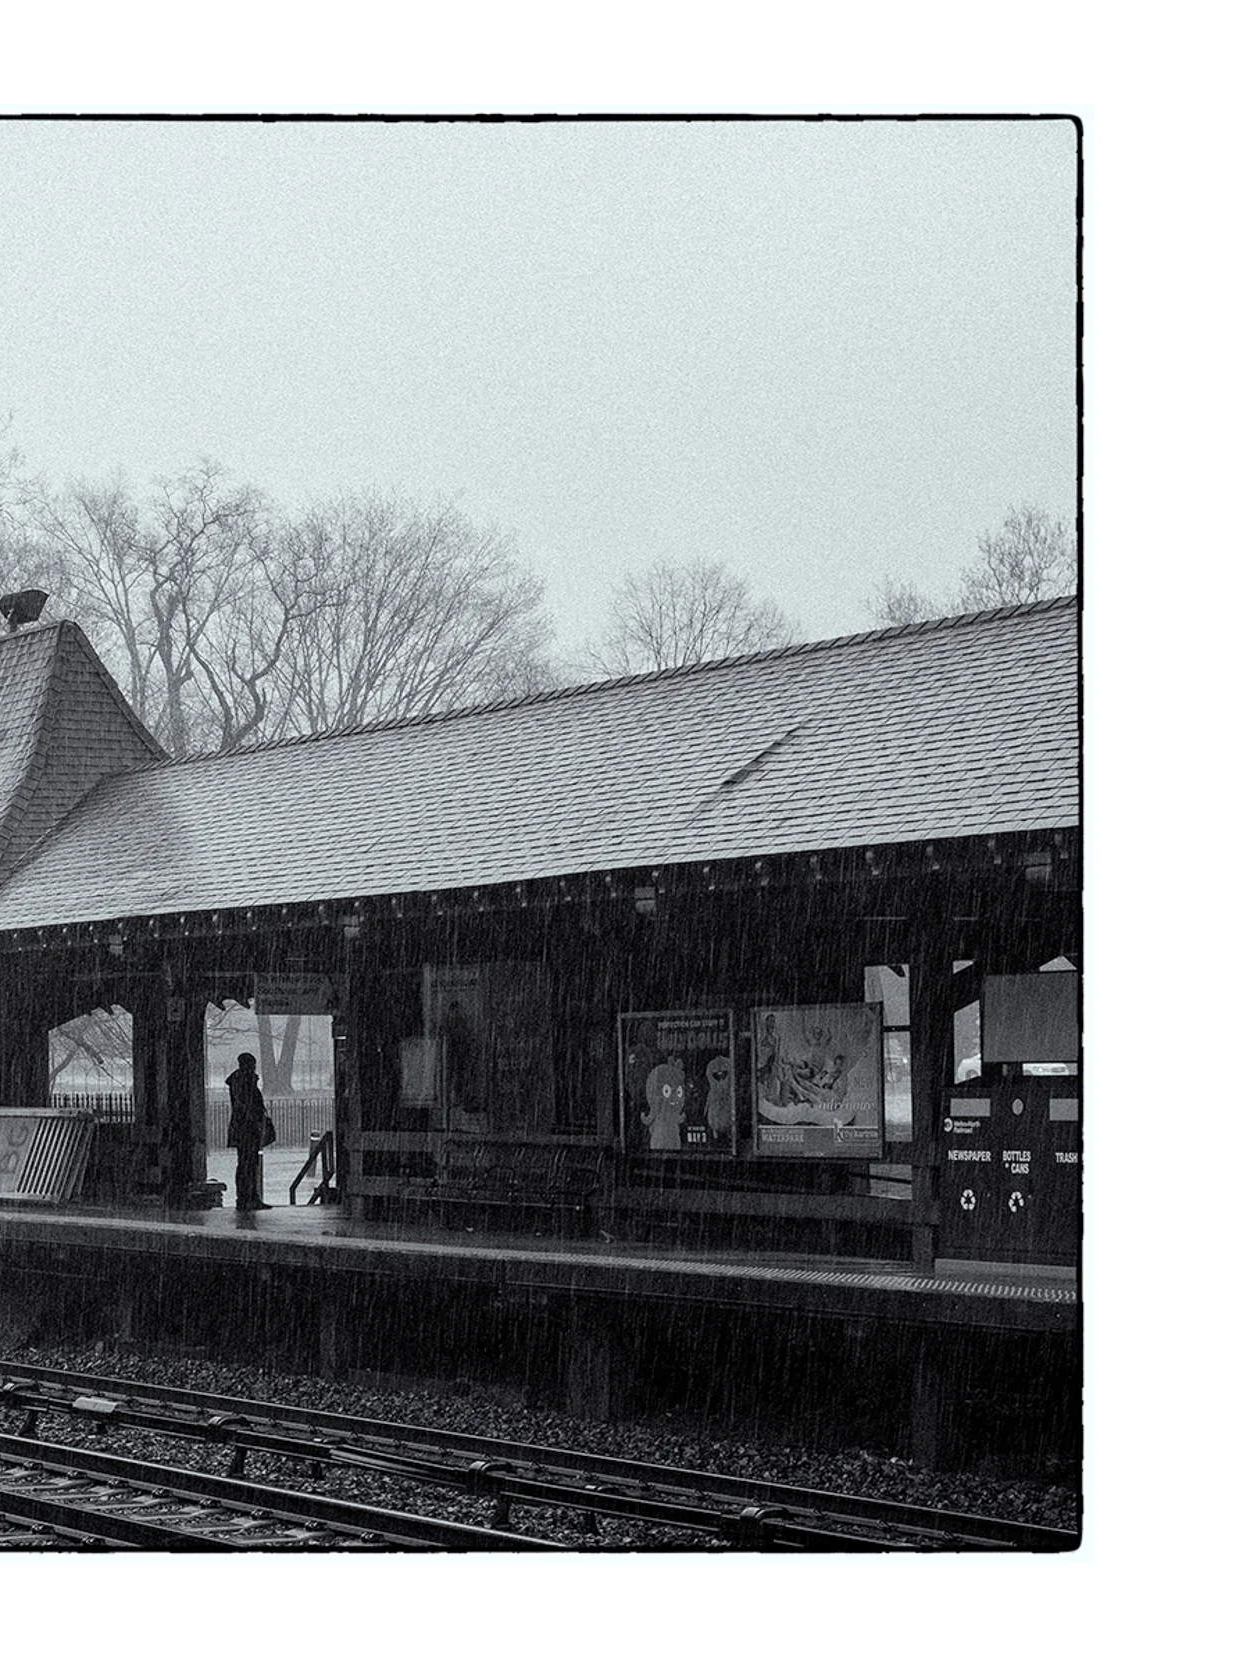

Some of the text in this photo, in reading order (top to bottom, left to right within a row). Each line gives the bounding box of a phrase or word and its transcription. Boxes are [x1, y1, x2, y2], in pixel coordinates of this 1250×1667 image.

[947, 1150, 992, 1162] NEWSPAPER
[1002, 1150, 1031, 1162] BOTTLES
[1055, 1152, 1079, 1163] TRASH
[1010, 1163, 1030, 1174] CANS
